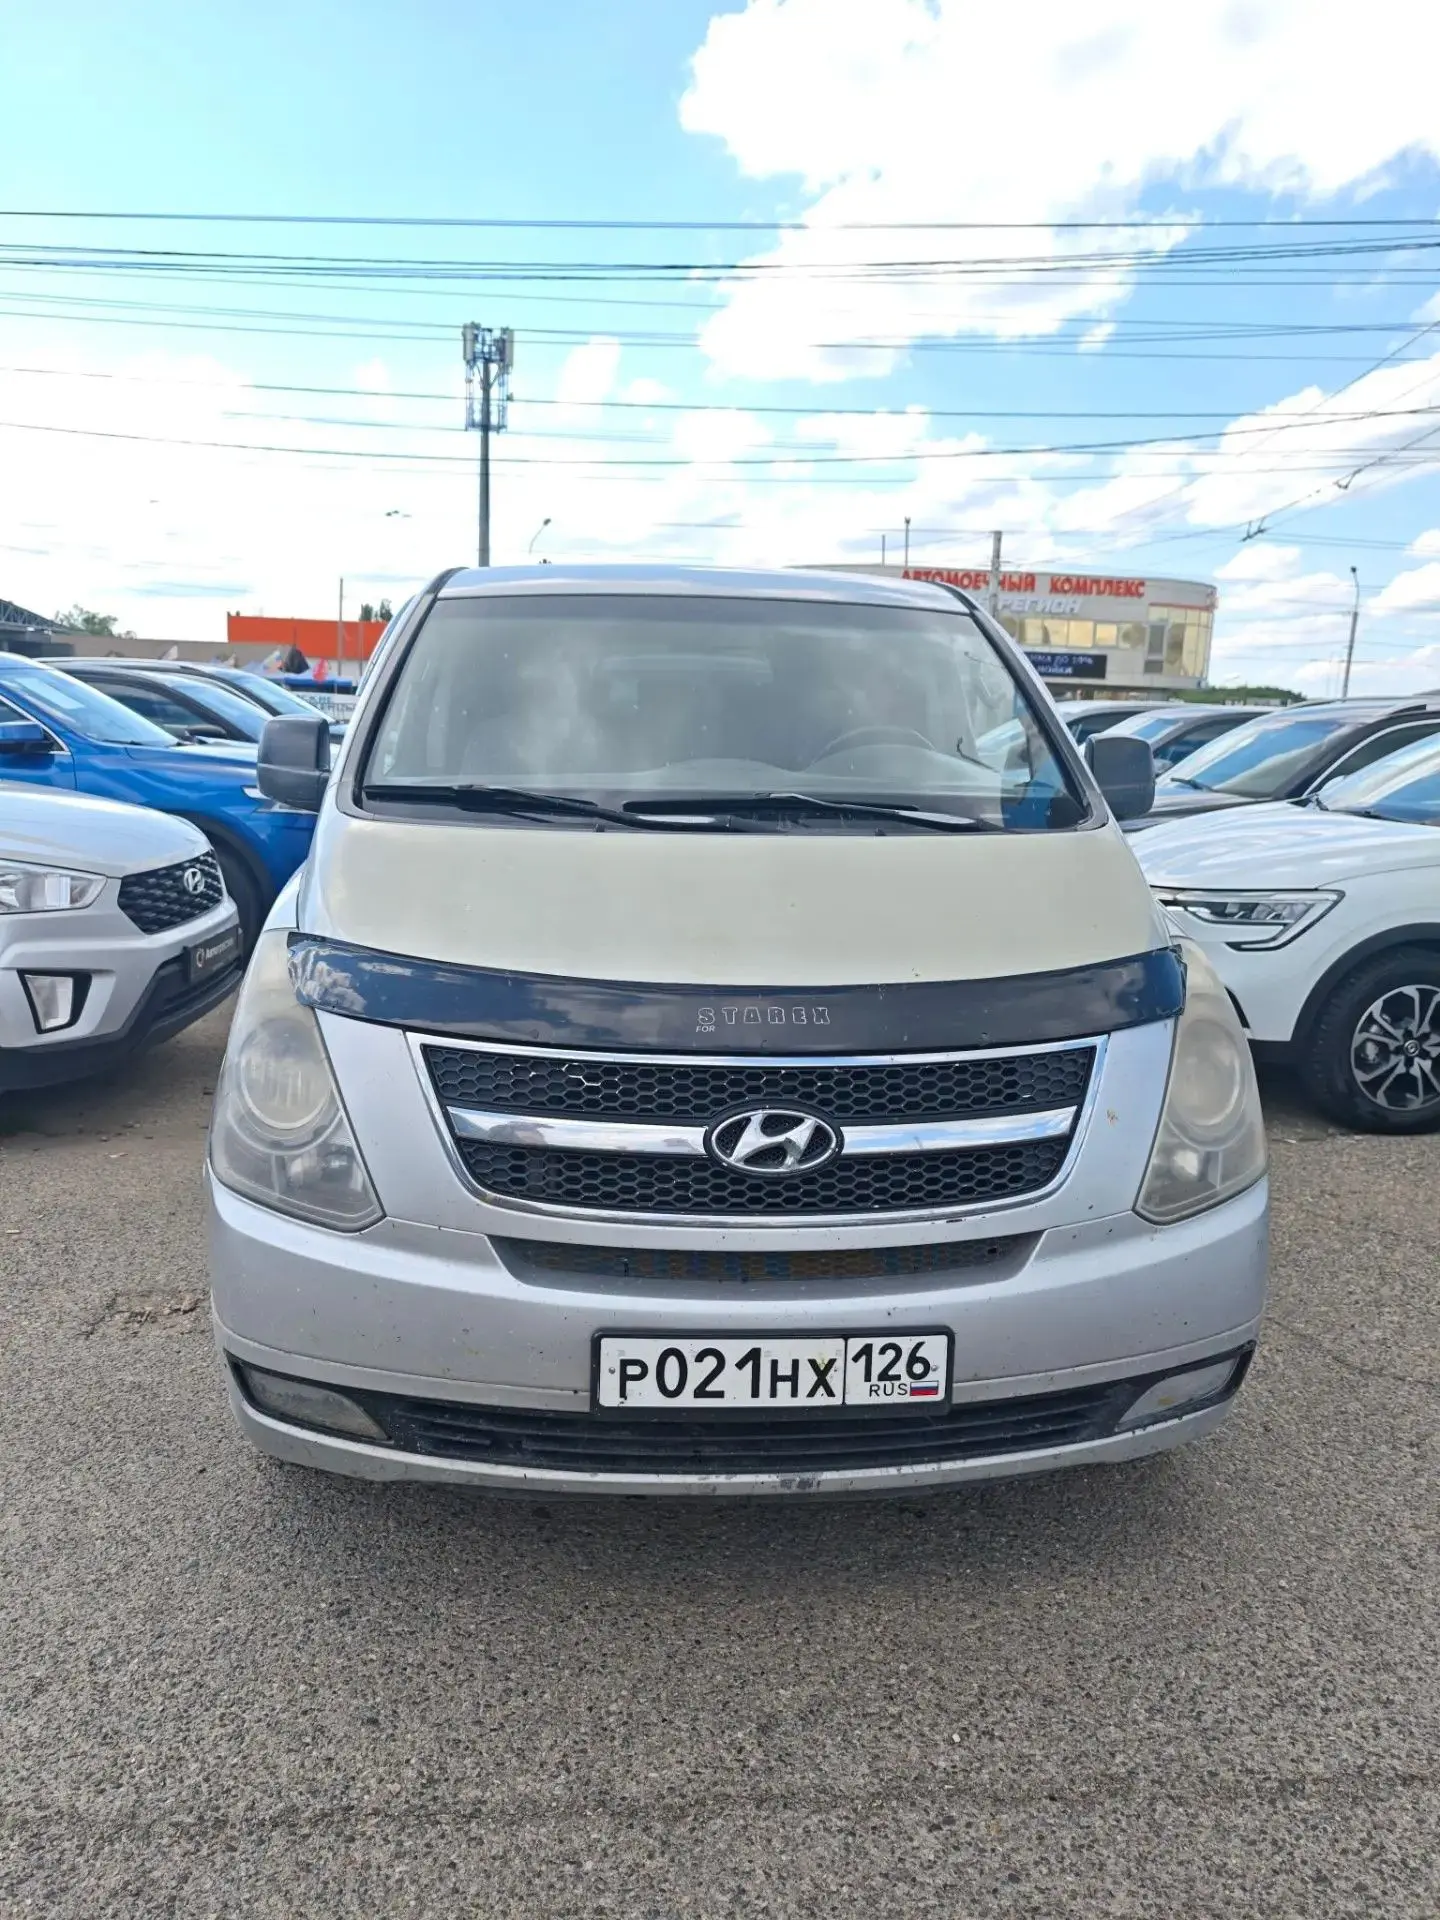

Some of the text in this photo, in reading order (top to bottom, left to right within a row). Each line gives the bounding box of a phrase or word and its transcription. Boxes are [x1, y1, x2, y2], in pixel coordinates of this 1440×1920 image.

[1049, 575, 1145, 598] КОМПЛЕКС
[998, 597, 1082, 614] РЕГИОН
[698, 1006, 830, 1025] STAREX
[696, 1025, 715, 1033] FOR
[851, 1341, 932, 1383] 126
[869, 1381, 909, 1397] RUS
